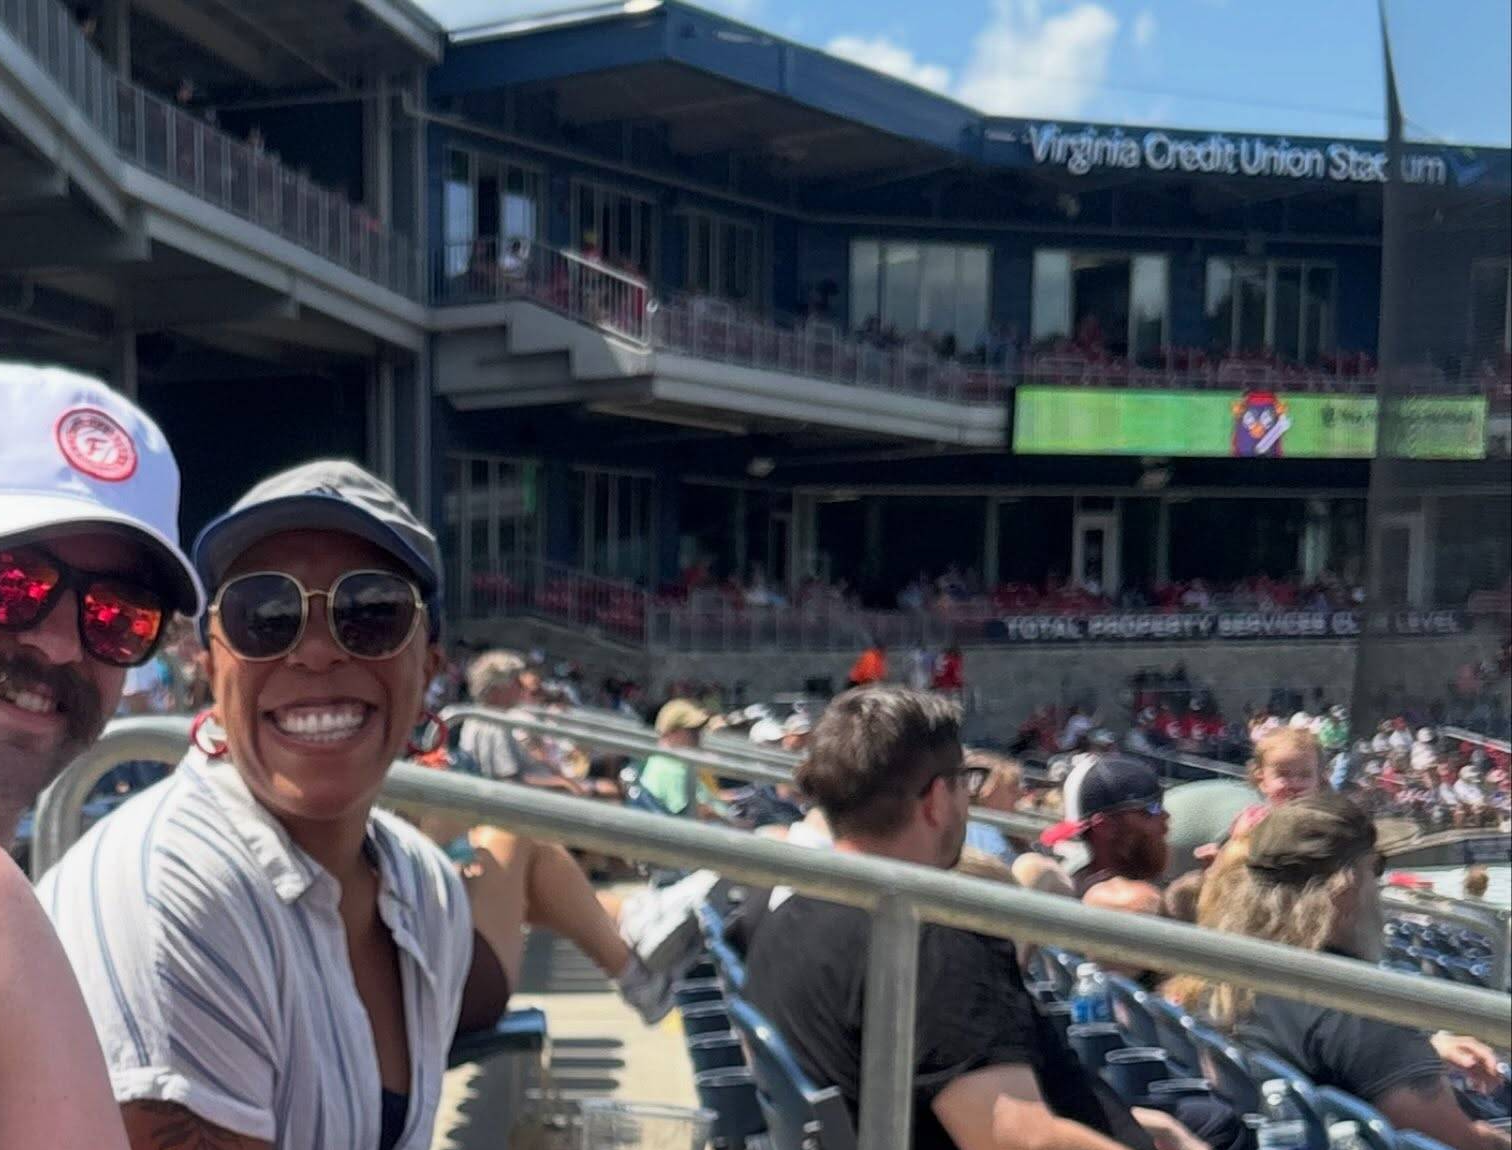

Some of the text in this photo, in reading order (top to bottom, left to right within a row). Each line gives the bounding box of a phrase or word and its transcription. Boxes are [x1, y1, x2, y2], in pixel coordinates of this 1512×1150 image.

[1028, 121, 1448, 185] Virginia Credit Union Staum
[1004, 615, 1084, 640] TOTAL
[1088, 613, 1215, 638] PROPERTY
[1218, 612, 1327, 637] SERVICES
